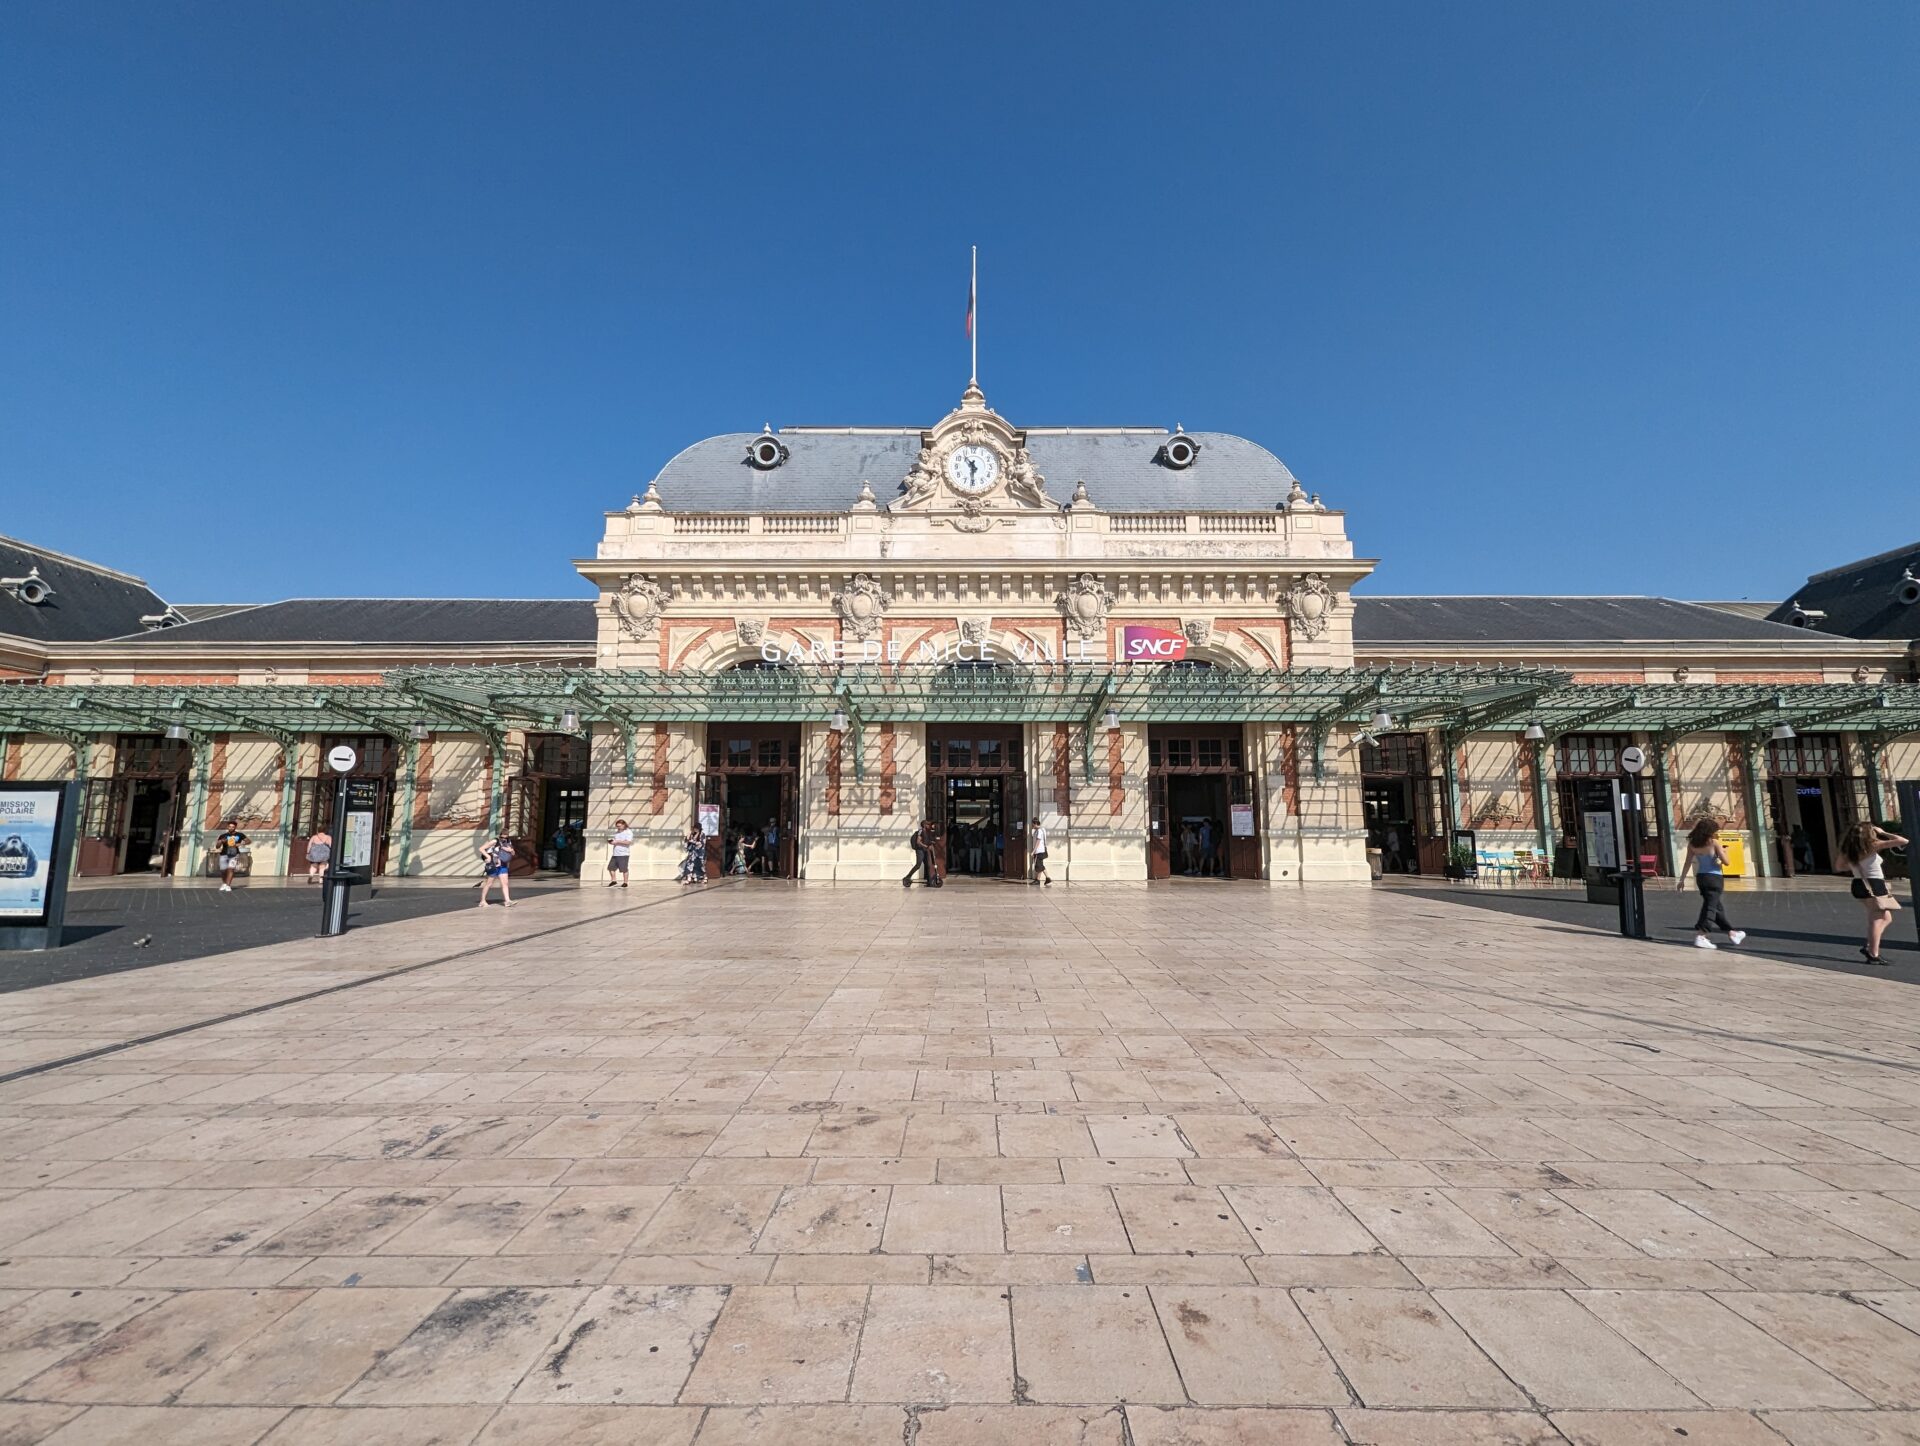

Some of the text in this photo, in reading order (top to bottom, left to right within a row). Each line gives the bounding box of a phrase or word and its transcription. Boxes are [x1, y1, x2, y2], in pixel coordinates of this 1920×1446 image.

[761, 639, 1094, 663] GARE DE NICE VILLE
[1127, 638, 1185, 656] SNCF
[0, 807, 35, 815] POLAIRE
